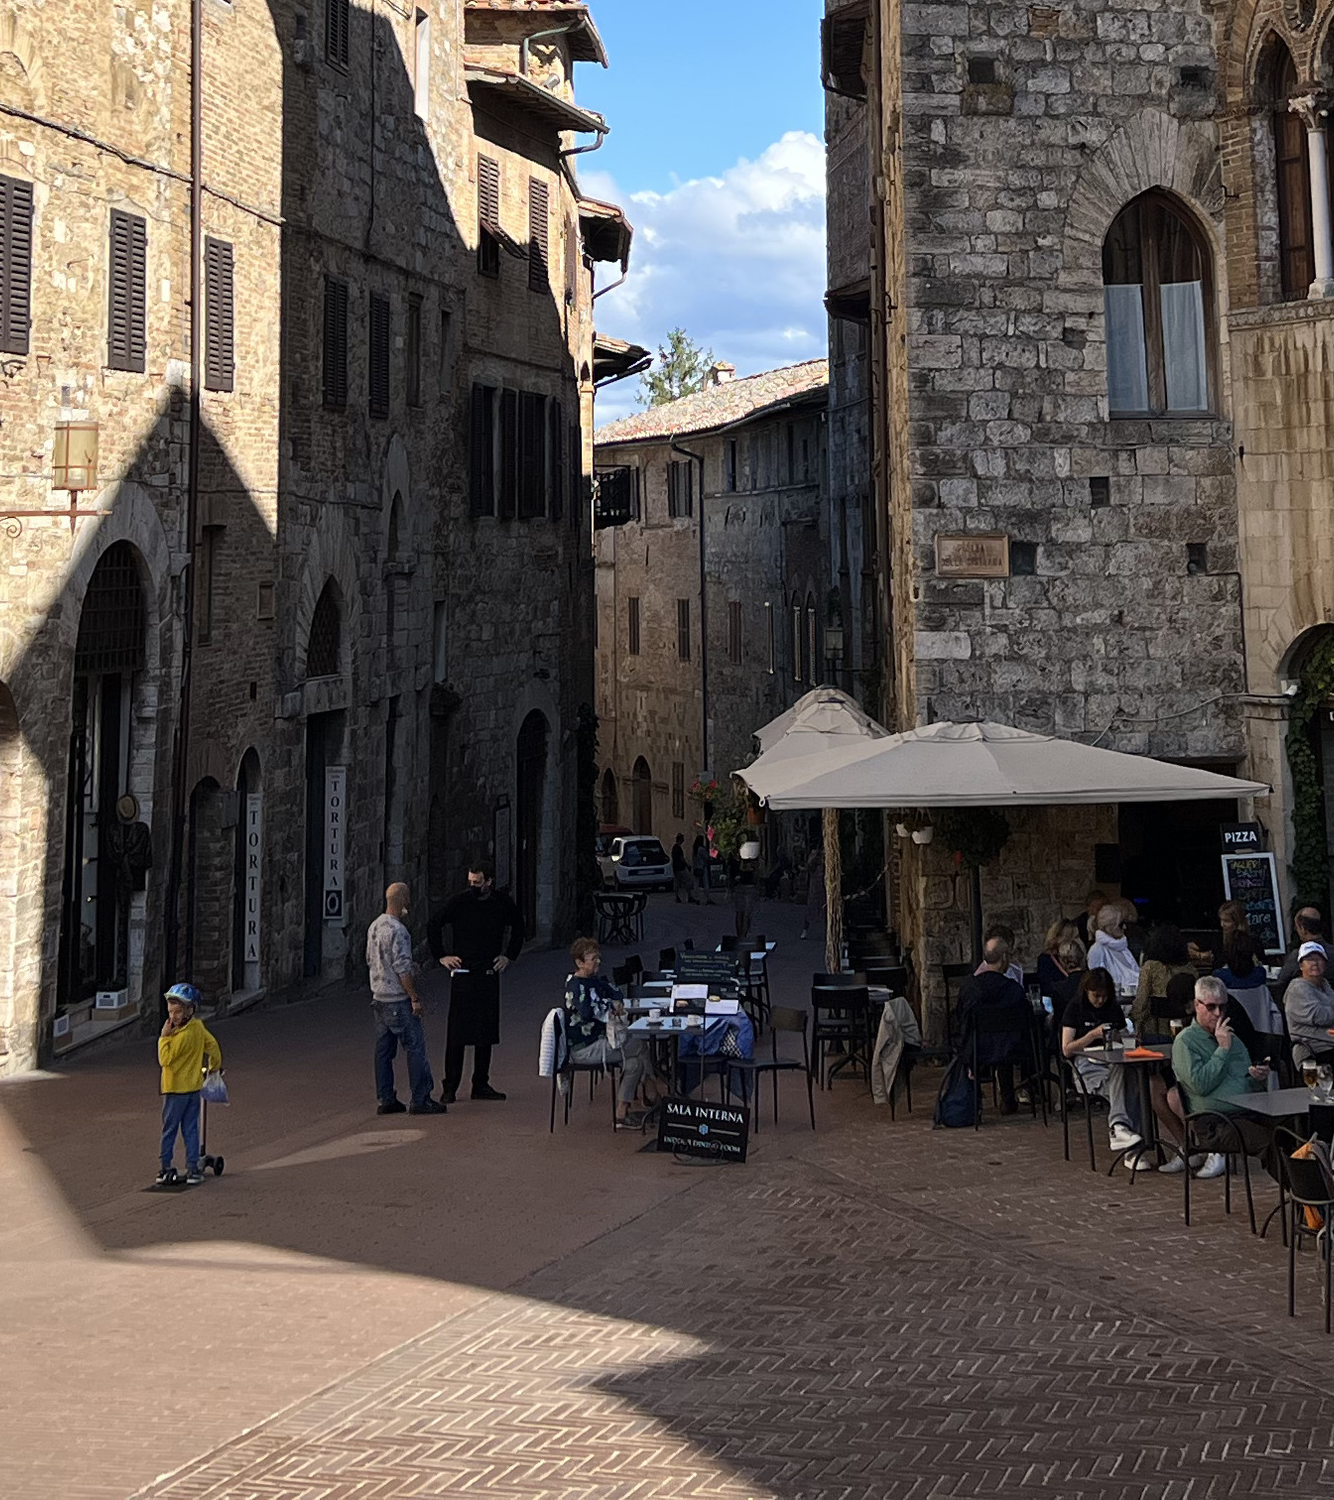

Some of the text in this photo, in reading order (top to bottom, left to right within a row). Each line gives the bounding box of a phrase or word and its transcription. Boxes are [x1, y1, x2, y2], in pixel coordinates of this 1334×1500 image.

[329, 780, 340, 887] TORTURA
[1224, 831, 1257, 843] PIZZA
[247, 810, 259, 958] TORTURA
[667, 1103, 744, 1124] SALA INTERNA
